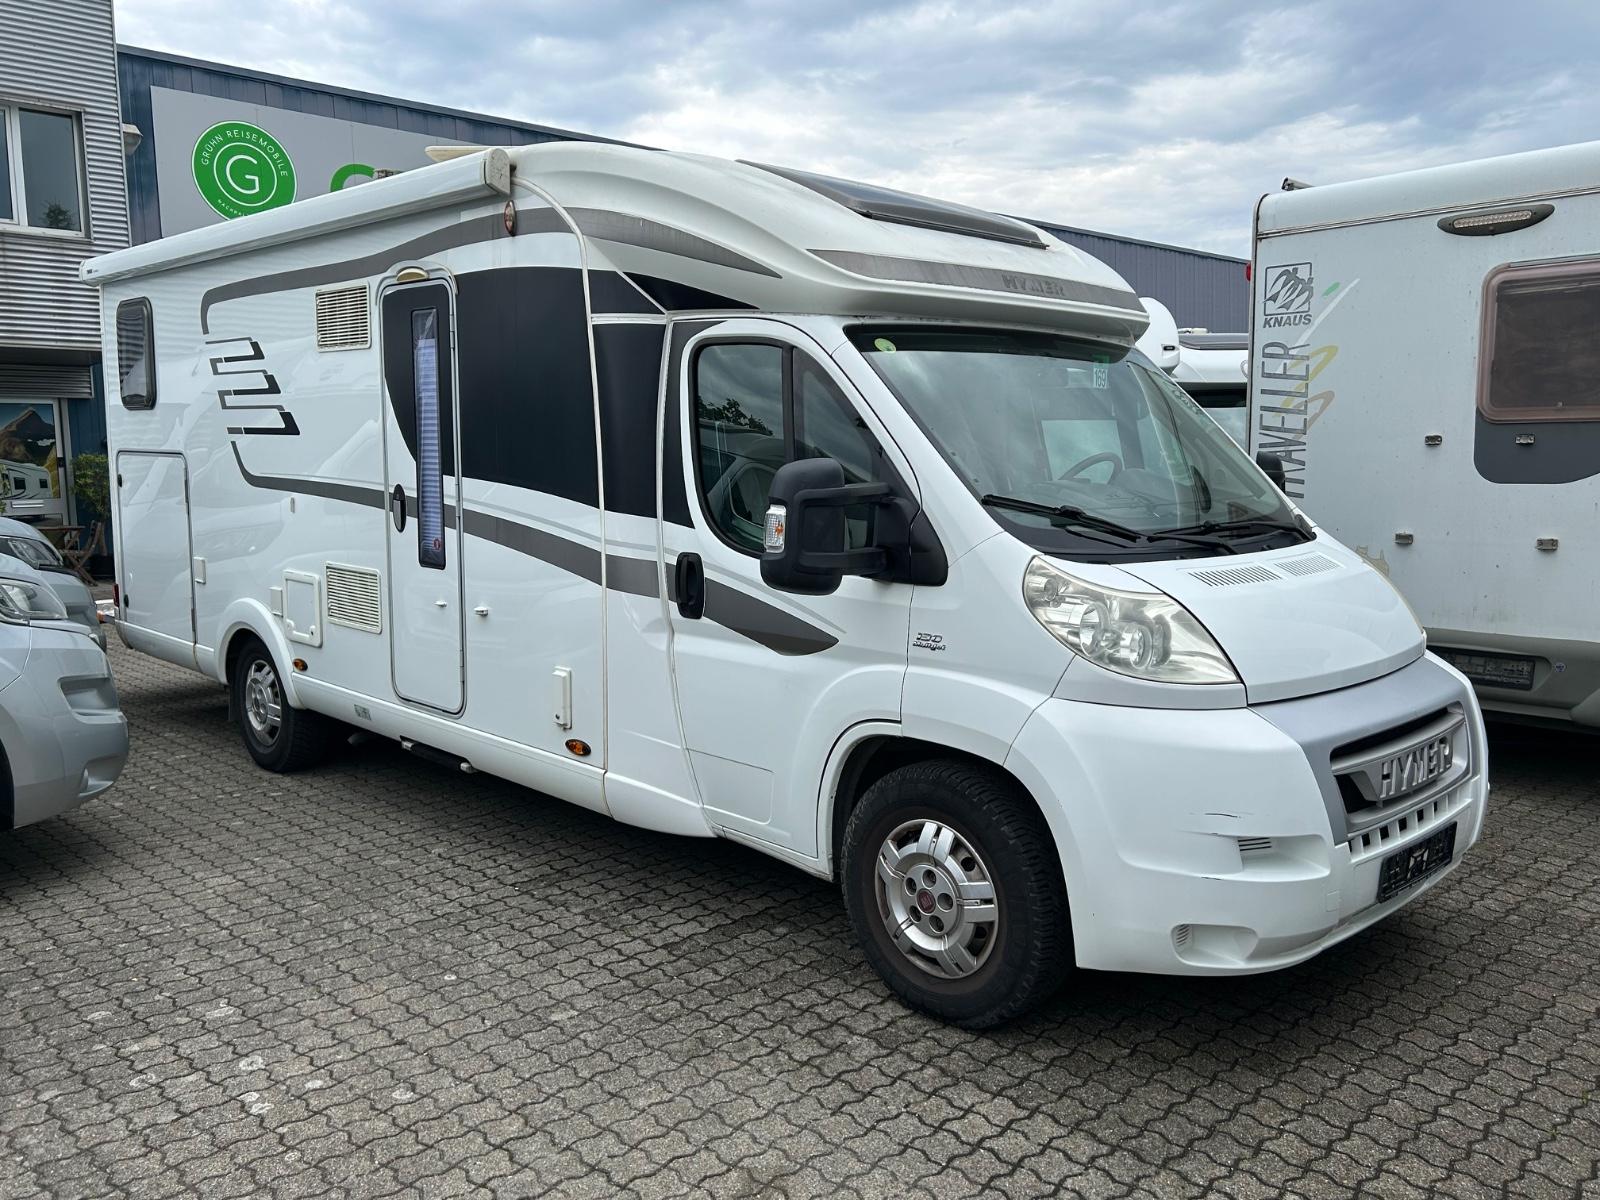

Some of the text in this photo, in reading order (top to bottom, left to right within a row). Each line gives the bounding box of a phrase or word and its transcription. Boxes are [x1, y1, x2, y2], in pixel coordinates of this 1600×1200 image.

[226, 129, 288, 177] REISEMOBILE
[226, 154, 259, 195] G
[1001, 273, 1066, 297] HYMER
[1262, 313, 1313, 329] KNAUS
[1379, 736, 1451, 799] HYMER
